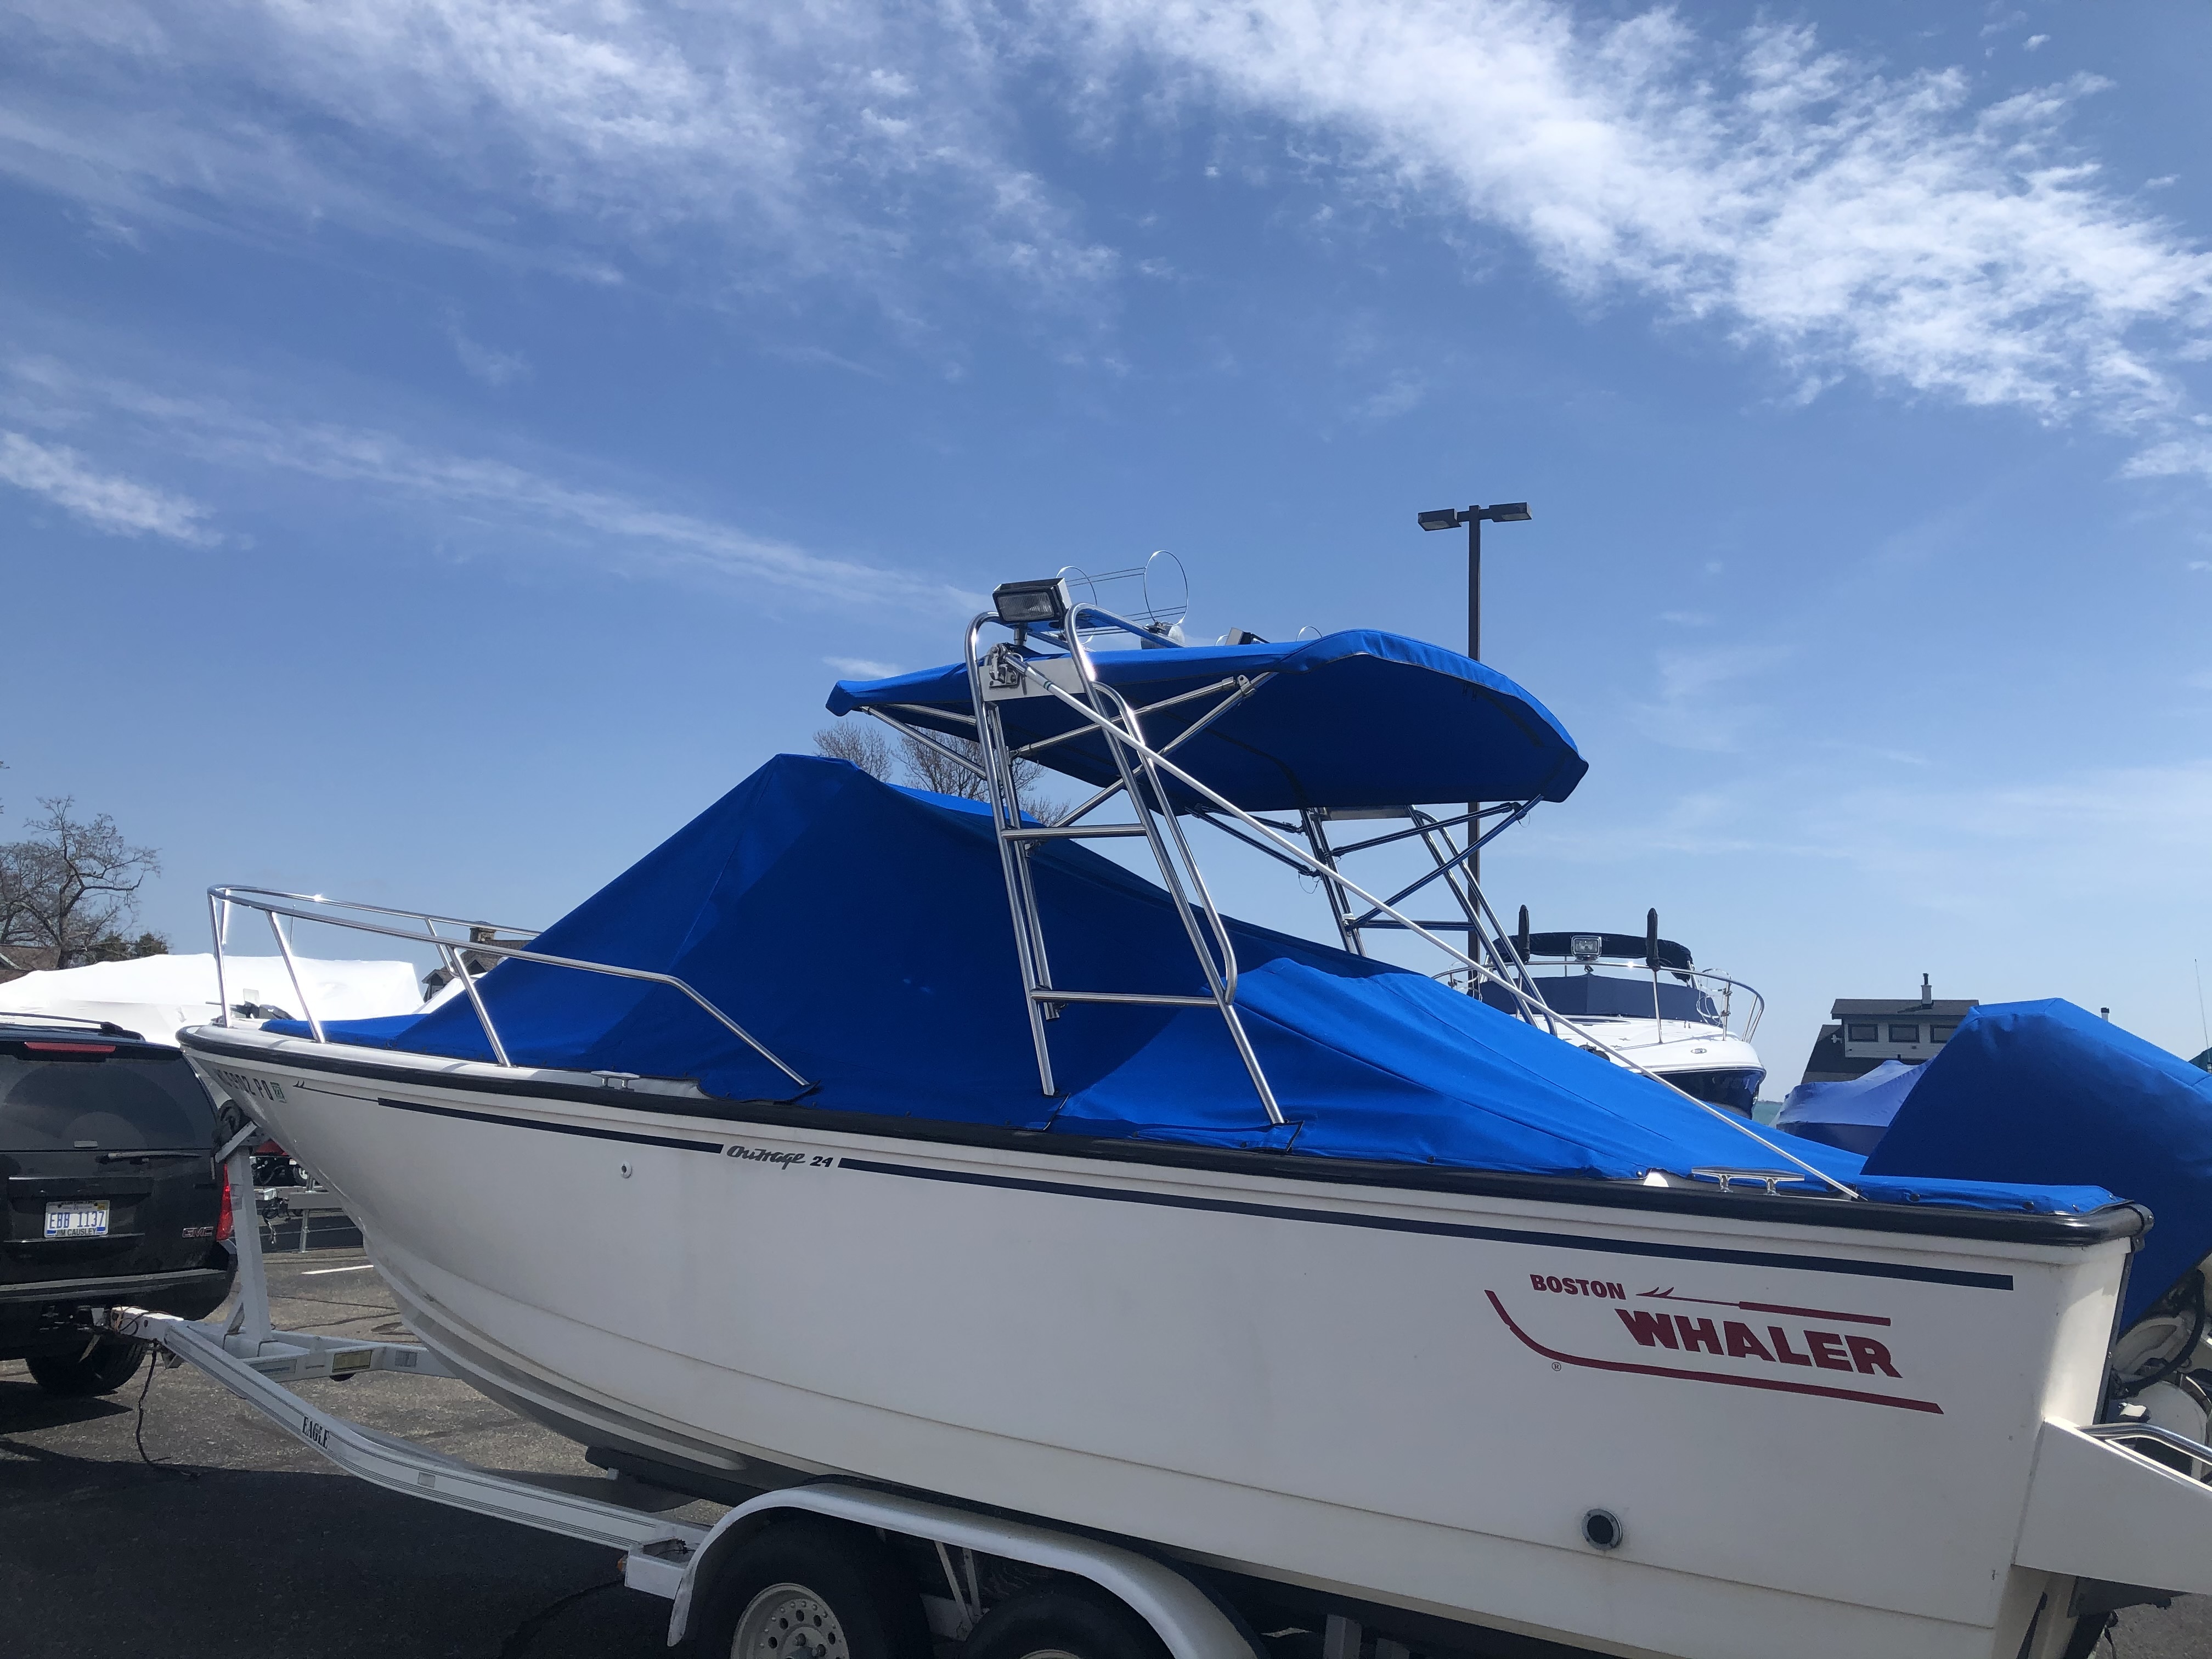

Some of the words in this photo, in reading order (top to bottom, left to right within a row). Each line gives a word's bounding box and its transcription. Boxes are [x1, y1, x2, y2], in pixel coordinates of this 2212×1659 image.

[726, 1145, 805, 1170] Outrage
[810, 1155, 833, 1167] 24
[49, 1212, 70, 1229] EBB
[77, 1210, 105, 1228] 1137
[67, 1228, 96, 1236] CAUSLEY
[182, 1226, 214, 1238] GMC
[1530, 1274, 1627, 1300] BOSTON
[1614, 1308, 1903, 1379] WHALER
[302, 1416, 330, 1449] EAGLE
